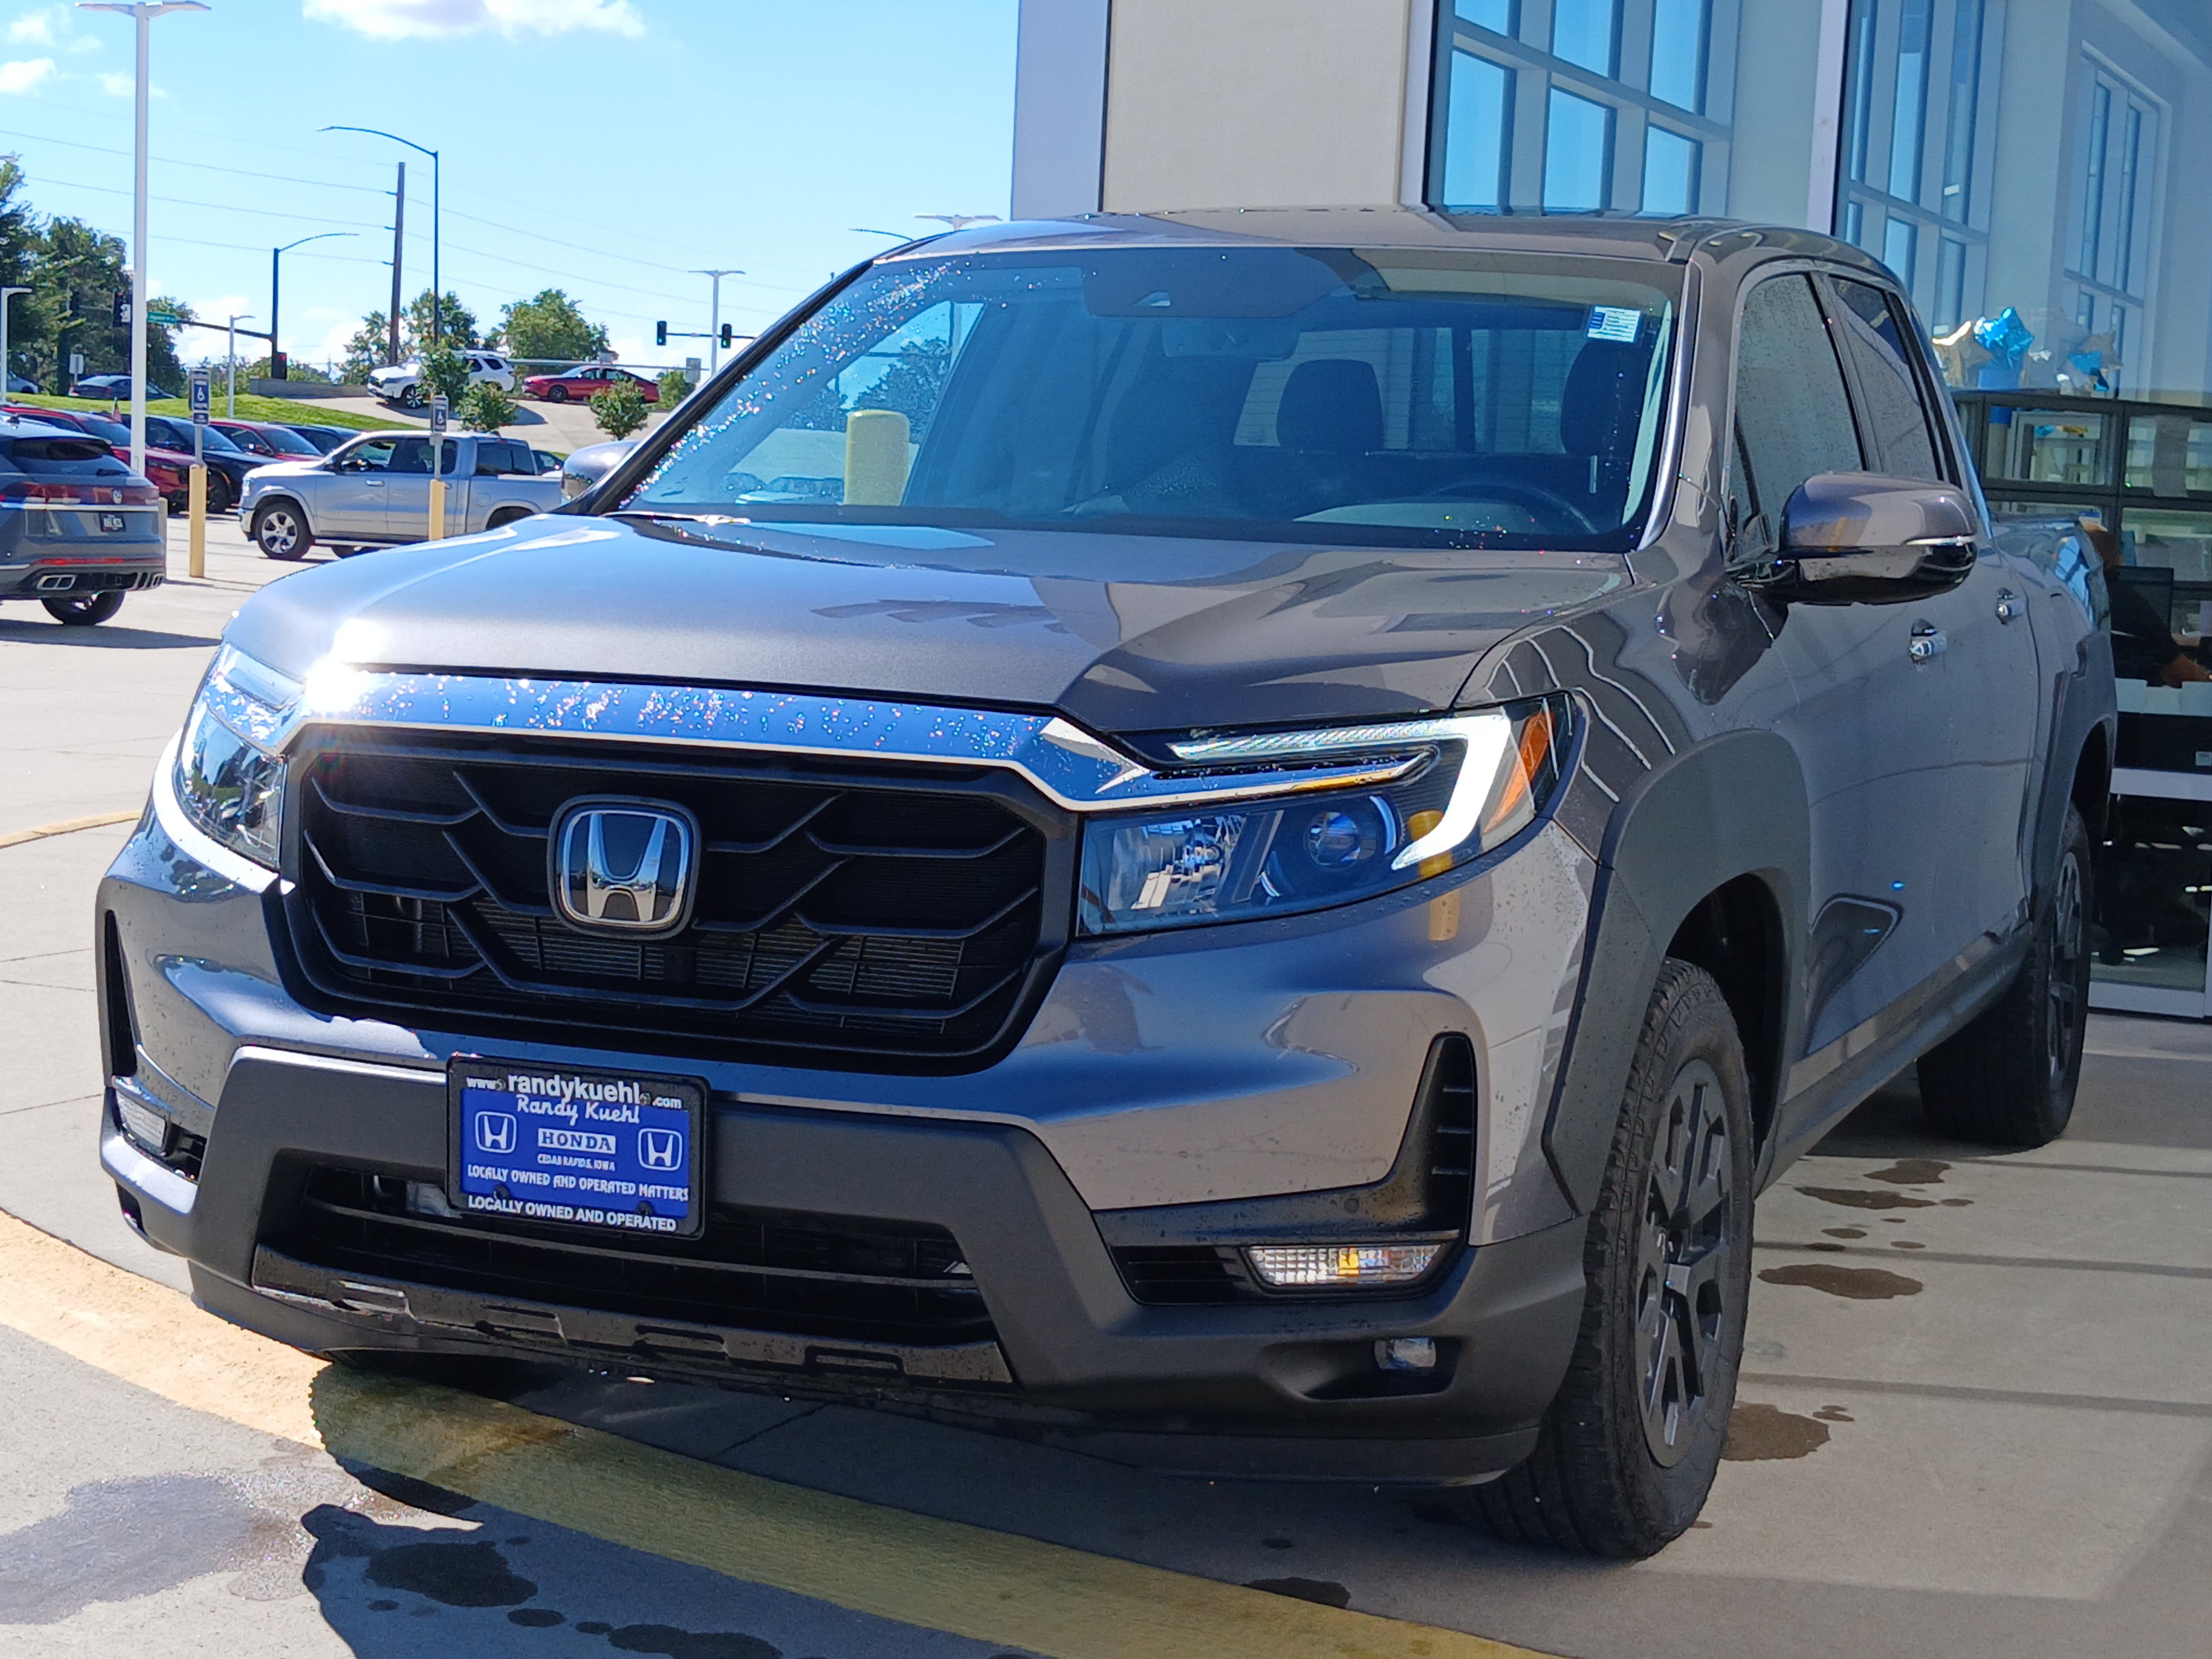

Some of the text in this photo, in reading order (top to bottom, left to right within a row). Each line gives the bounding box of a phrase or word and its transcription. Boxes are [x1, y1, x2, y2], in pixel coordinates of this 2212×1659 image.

[507, 1074, 640, 1104] randykuehl
[652, 1097, 681, 1109] .com
[516, 1094, 640, 1126] Randy Kuehl
[542, 1131, 612, 1150] HONDA
[468, 1163, 689, 1201] LOCALLY OWNED AND OPERATED MATTERS
[468, 1195, 676, 1232] LOCALLY OWNED AND OPERATED
